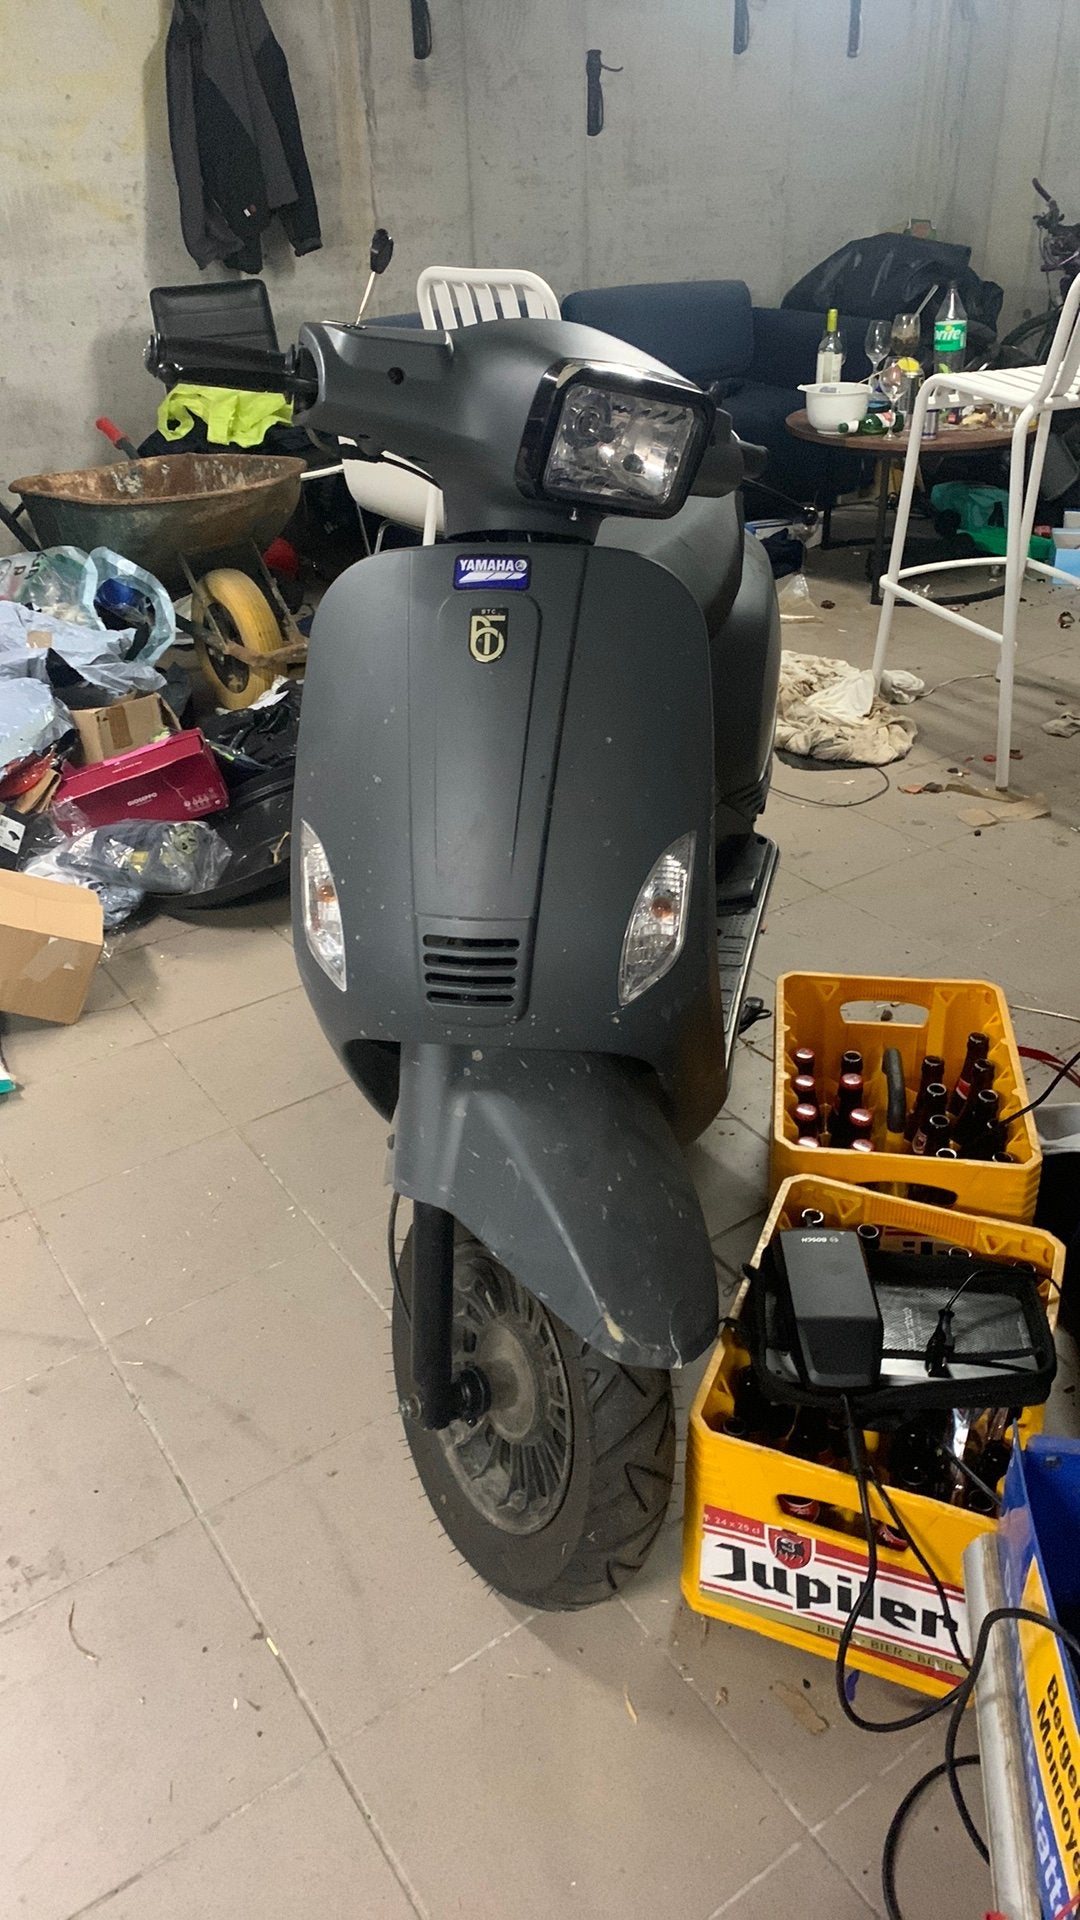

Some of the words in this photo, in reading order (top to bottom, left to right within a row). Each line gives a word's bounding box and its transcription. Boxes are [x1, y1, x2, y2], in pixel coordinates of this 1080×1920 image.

[460, 559, 515, 571] YAMAHA
[714, 1516, 727, 1526] 24
[737, 1522, 750, 1532] 25
[711, 1542, 958, 1638] Jupiler
[870, 1640, 903, 1659] BIER
[1046, 1673, 1080, 1822] Berger
